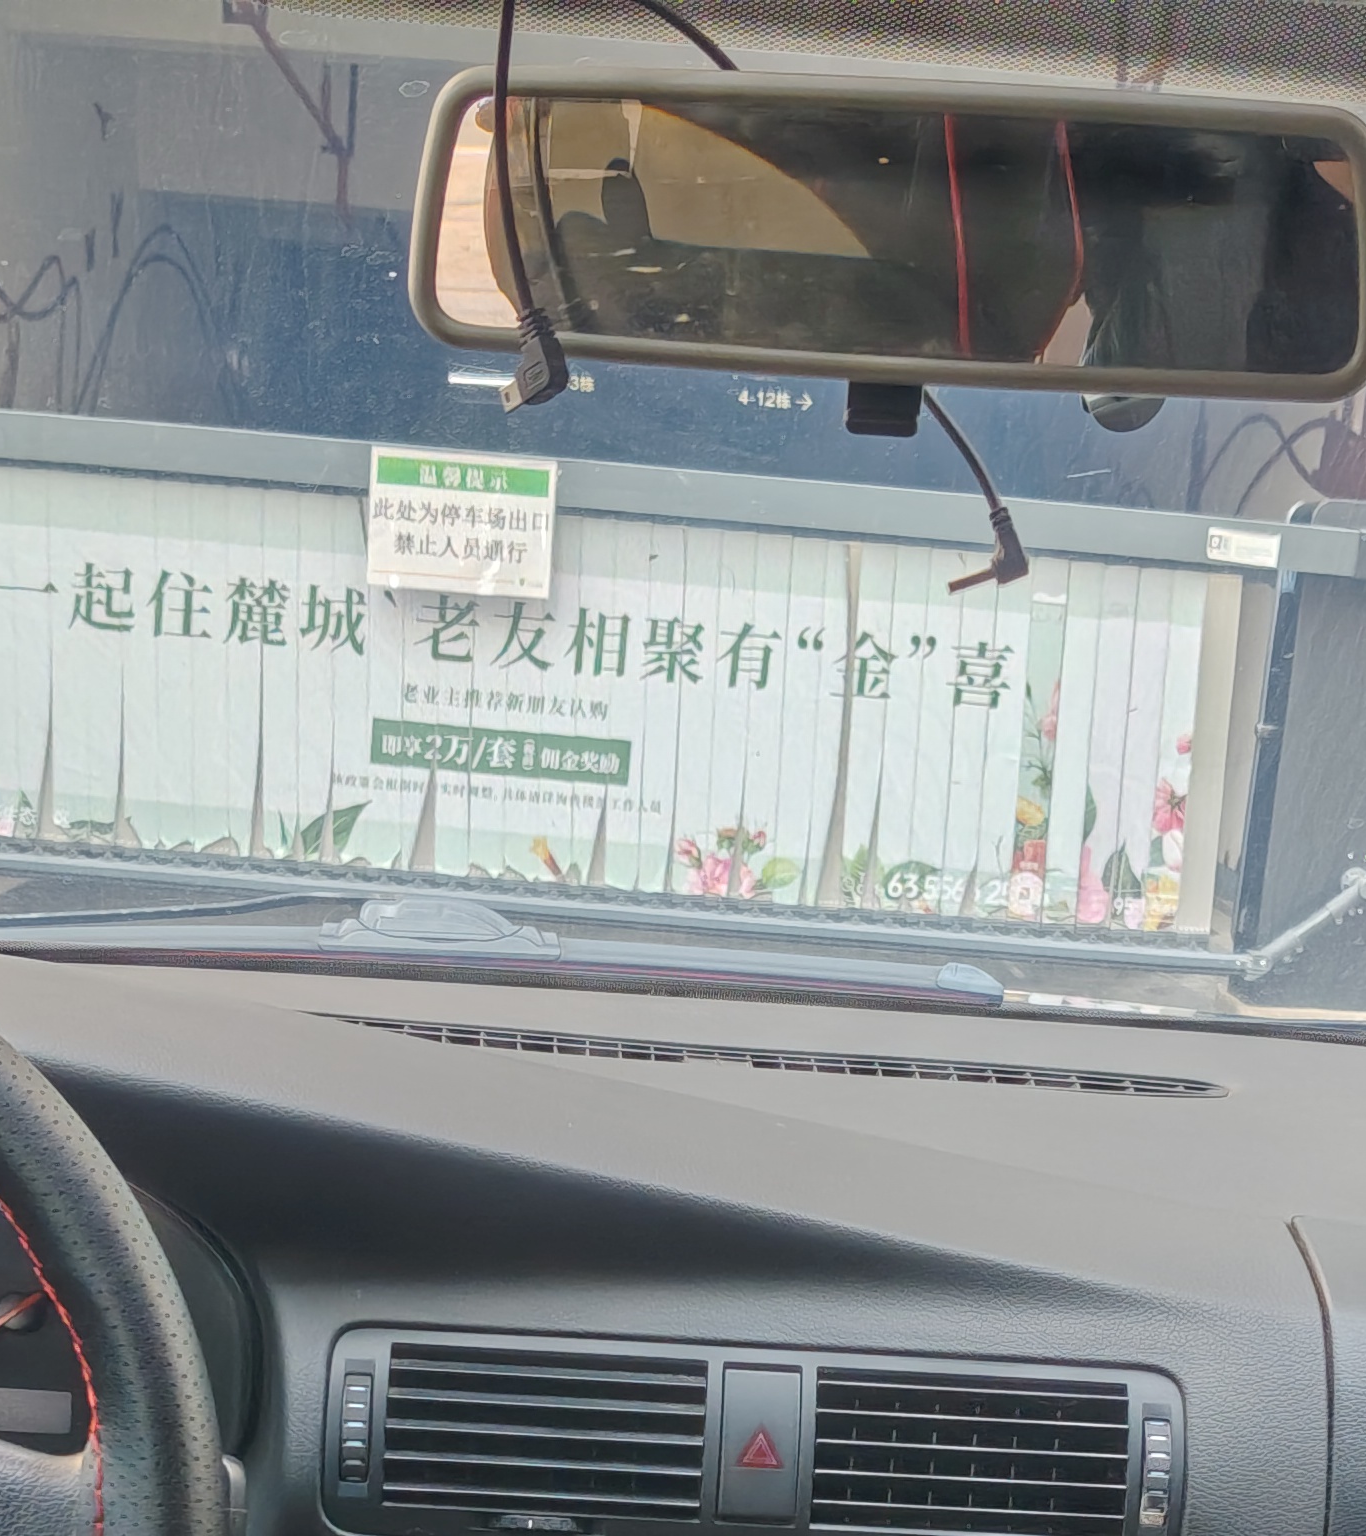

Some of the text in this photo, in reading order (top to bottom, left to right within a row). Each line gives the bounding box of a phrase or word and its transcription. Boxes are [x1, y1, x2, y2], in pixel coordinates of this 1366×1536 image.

[419, 463, 508, 491] 温馨提示
[372, 497, 550, 532] 此处为停车场出口
[394, 531, 528, 564] 禁止人员通行
